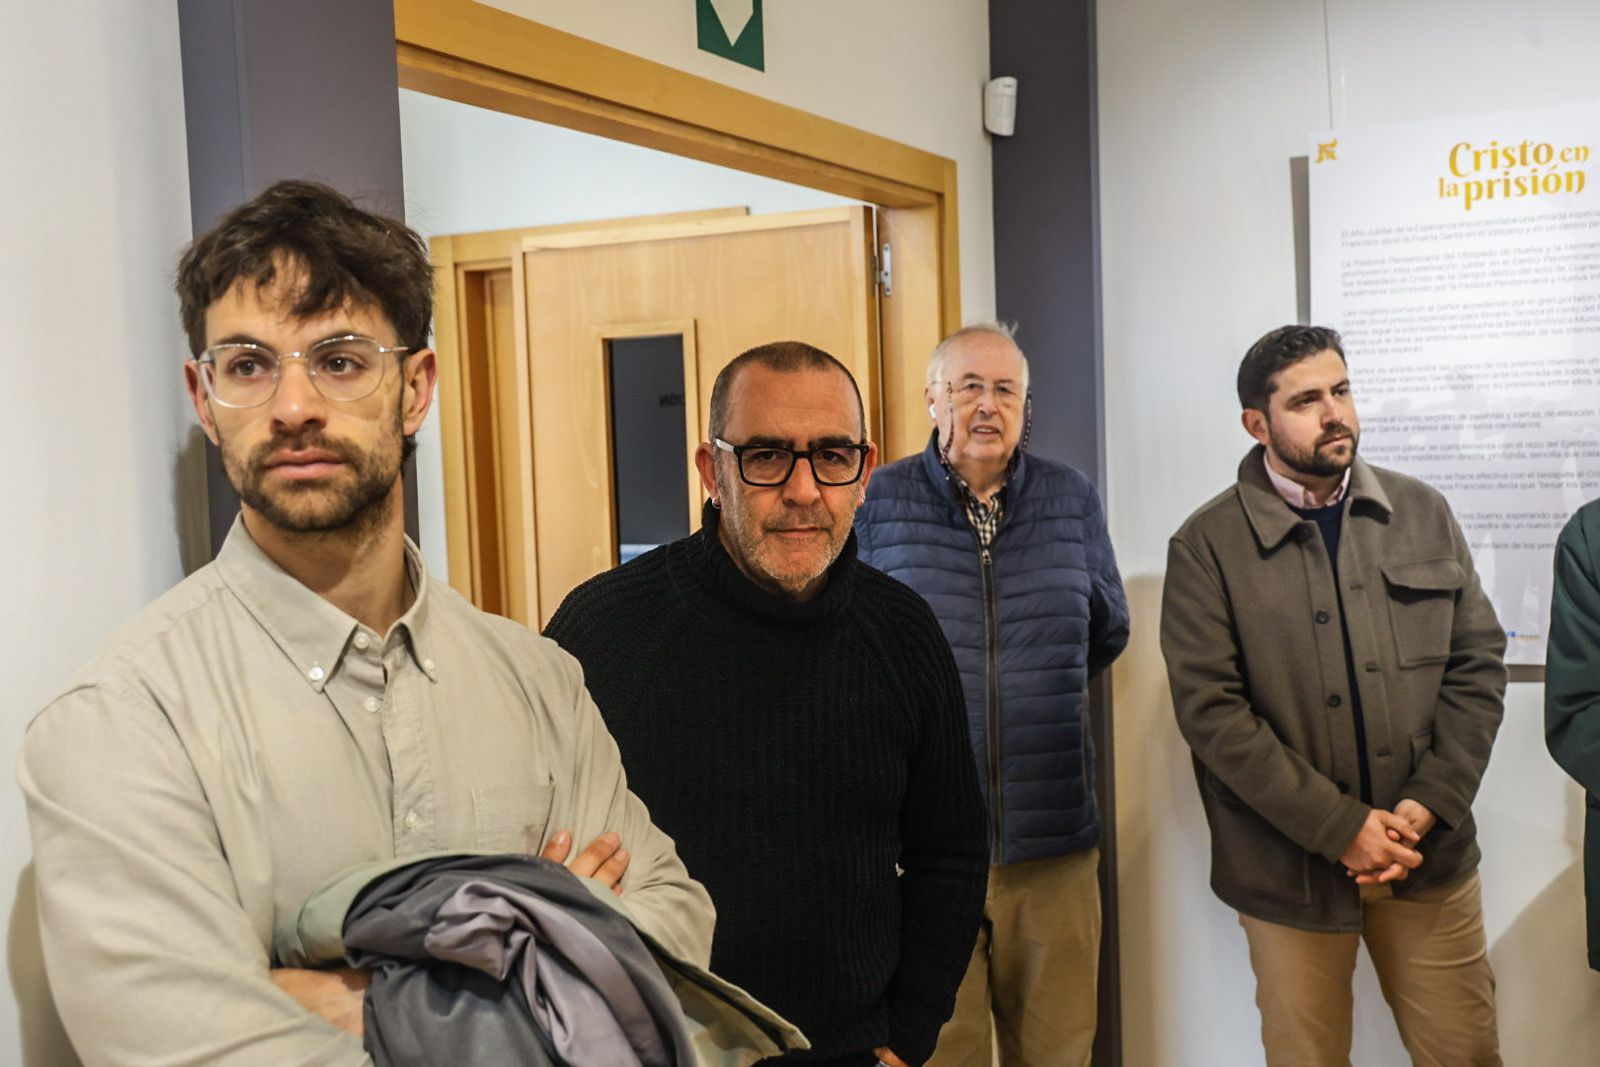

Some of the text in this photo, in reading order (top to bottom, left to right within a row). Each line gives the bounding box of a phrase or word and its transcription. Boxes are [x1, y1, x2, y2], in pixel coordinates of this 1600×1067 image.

[1449, 139, 1591, 178] Cristo en
[1439, 164, 1586, 211] la prisión
